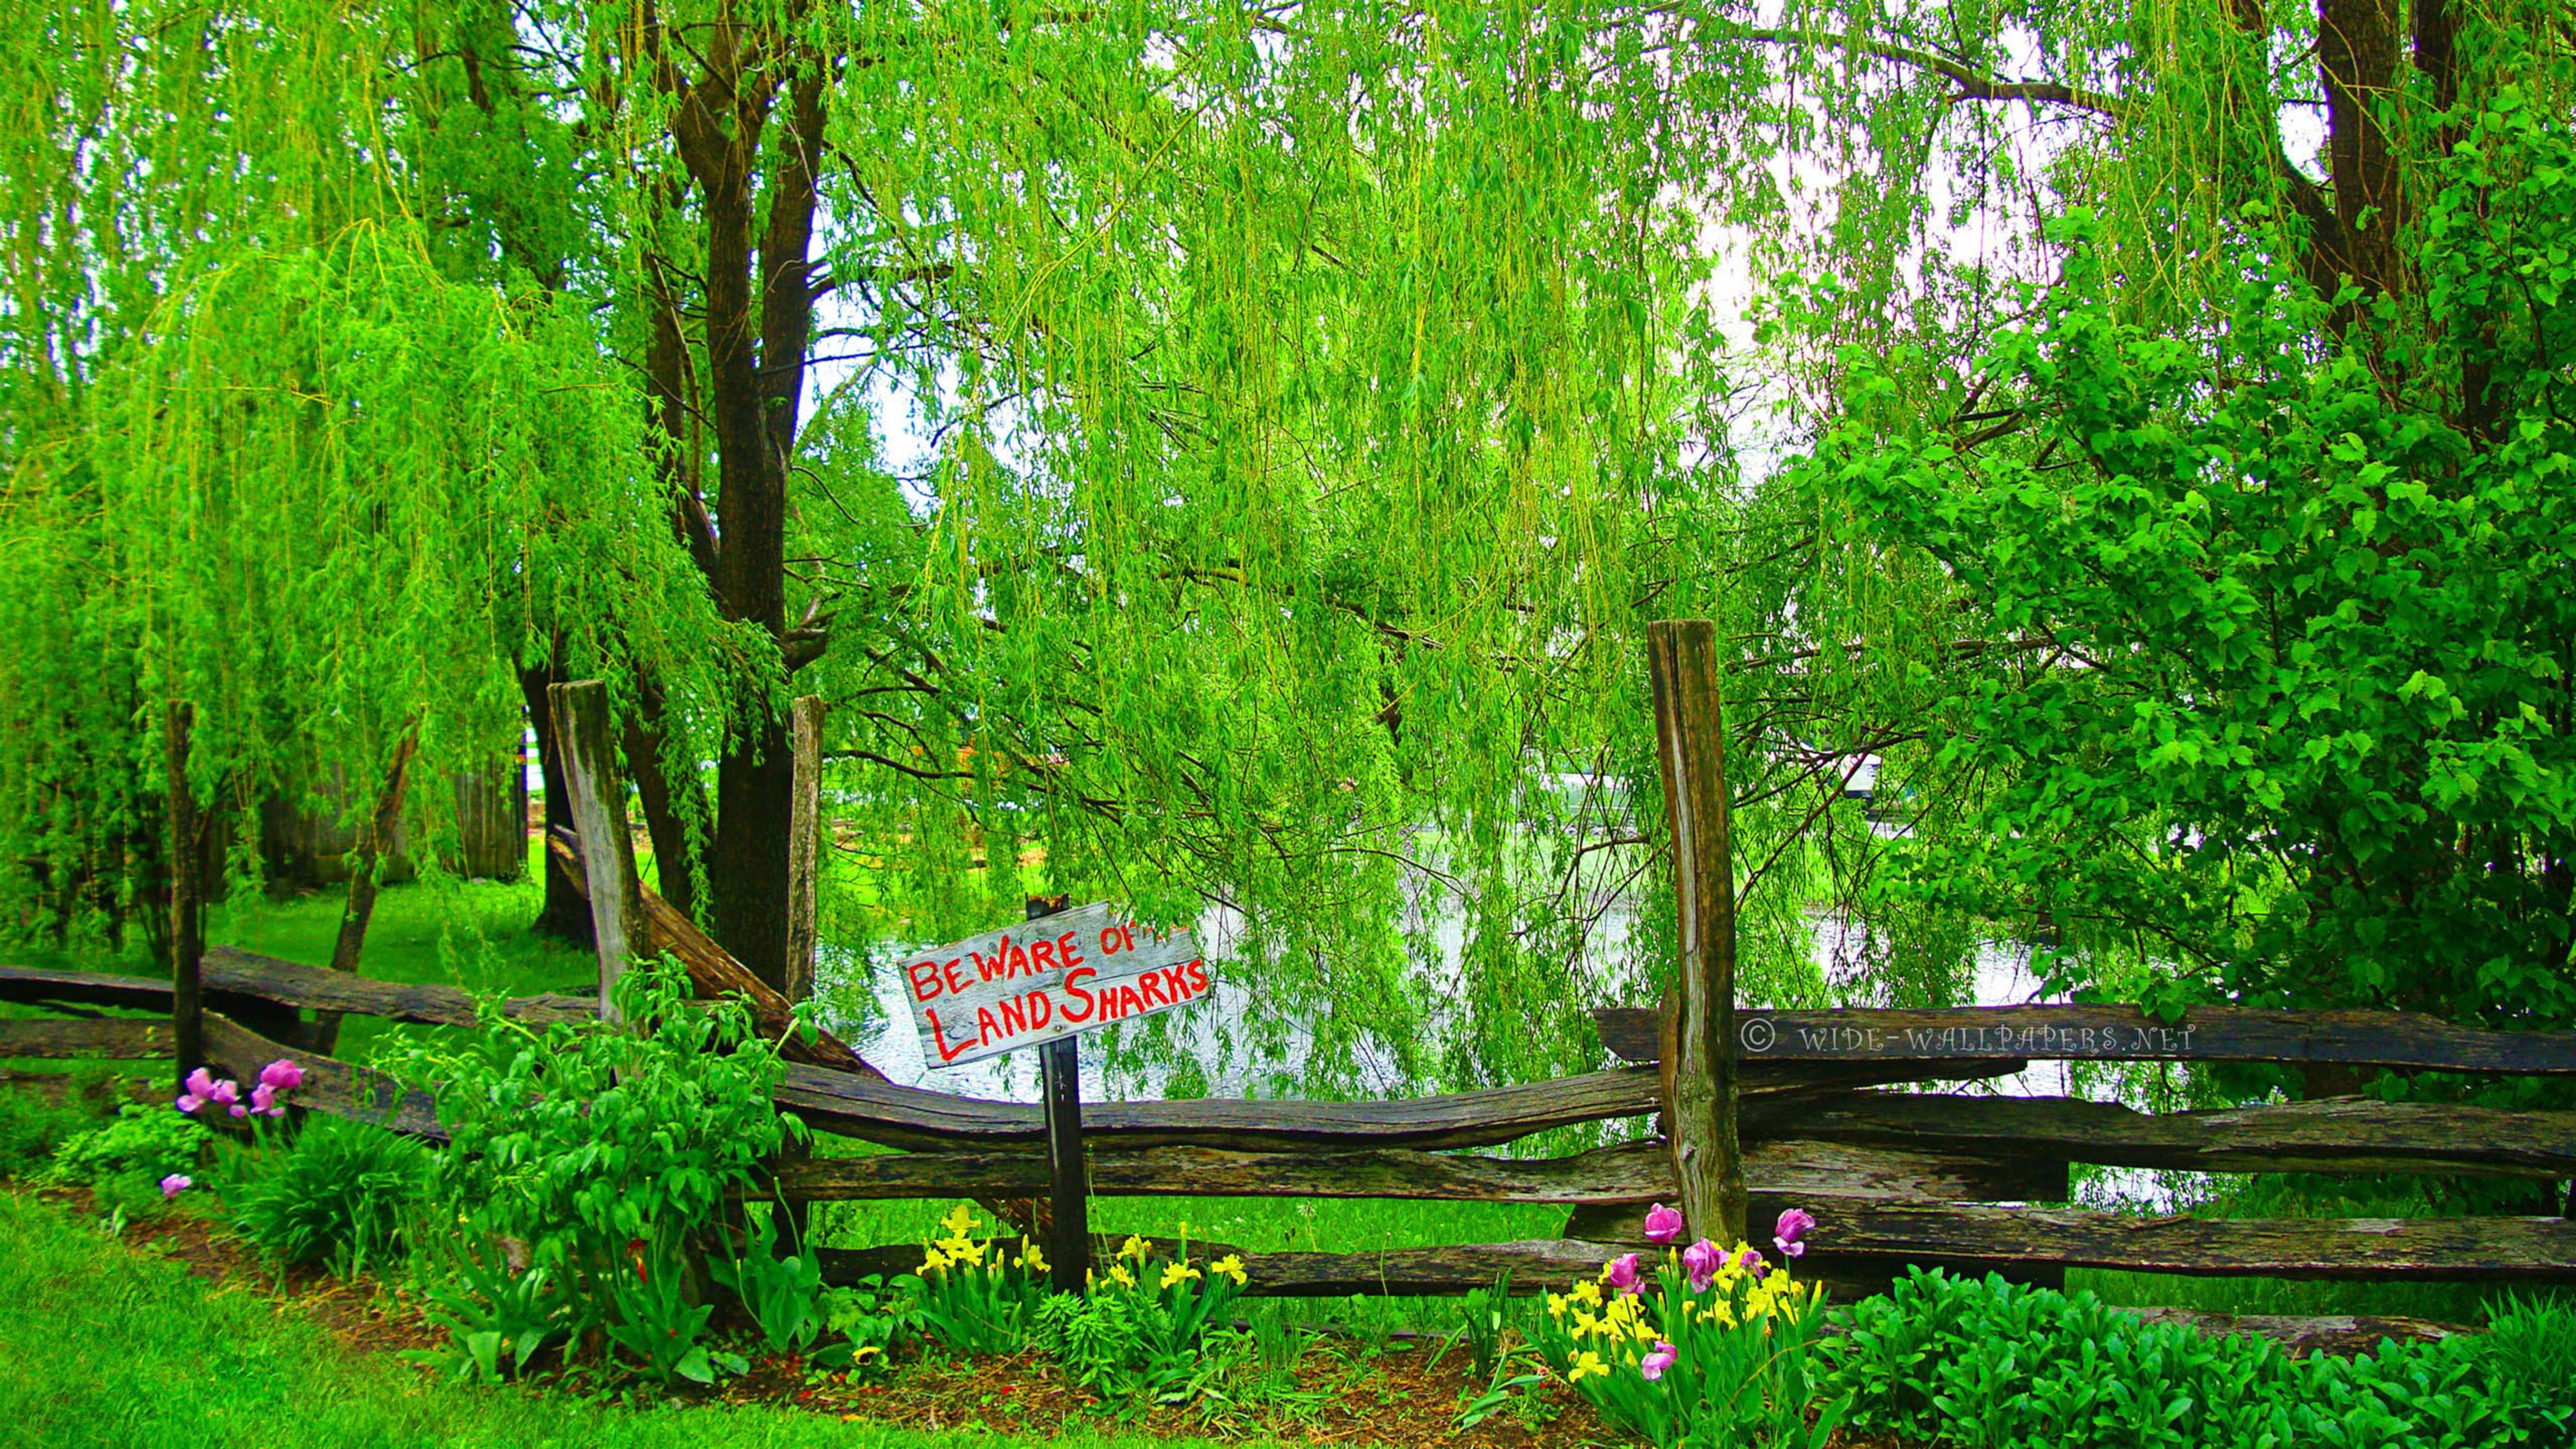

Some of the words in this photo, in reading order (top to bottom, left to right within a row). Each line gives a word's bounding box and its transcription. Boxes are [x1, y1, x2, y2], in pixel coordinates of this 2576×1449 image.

[908, 931, 1084, 1002] BEWARE
[925, 991, 1051, 1062] LAND
[1060, 959, 1209, 1023] SHARKS
